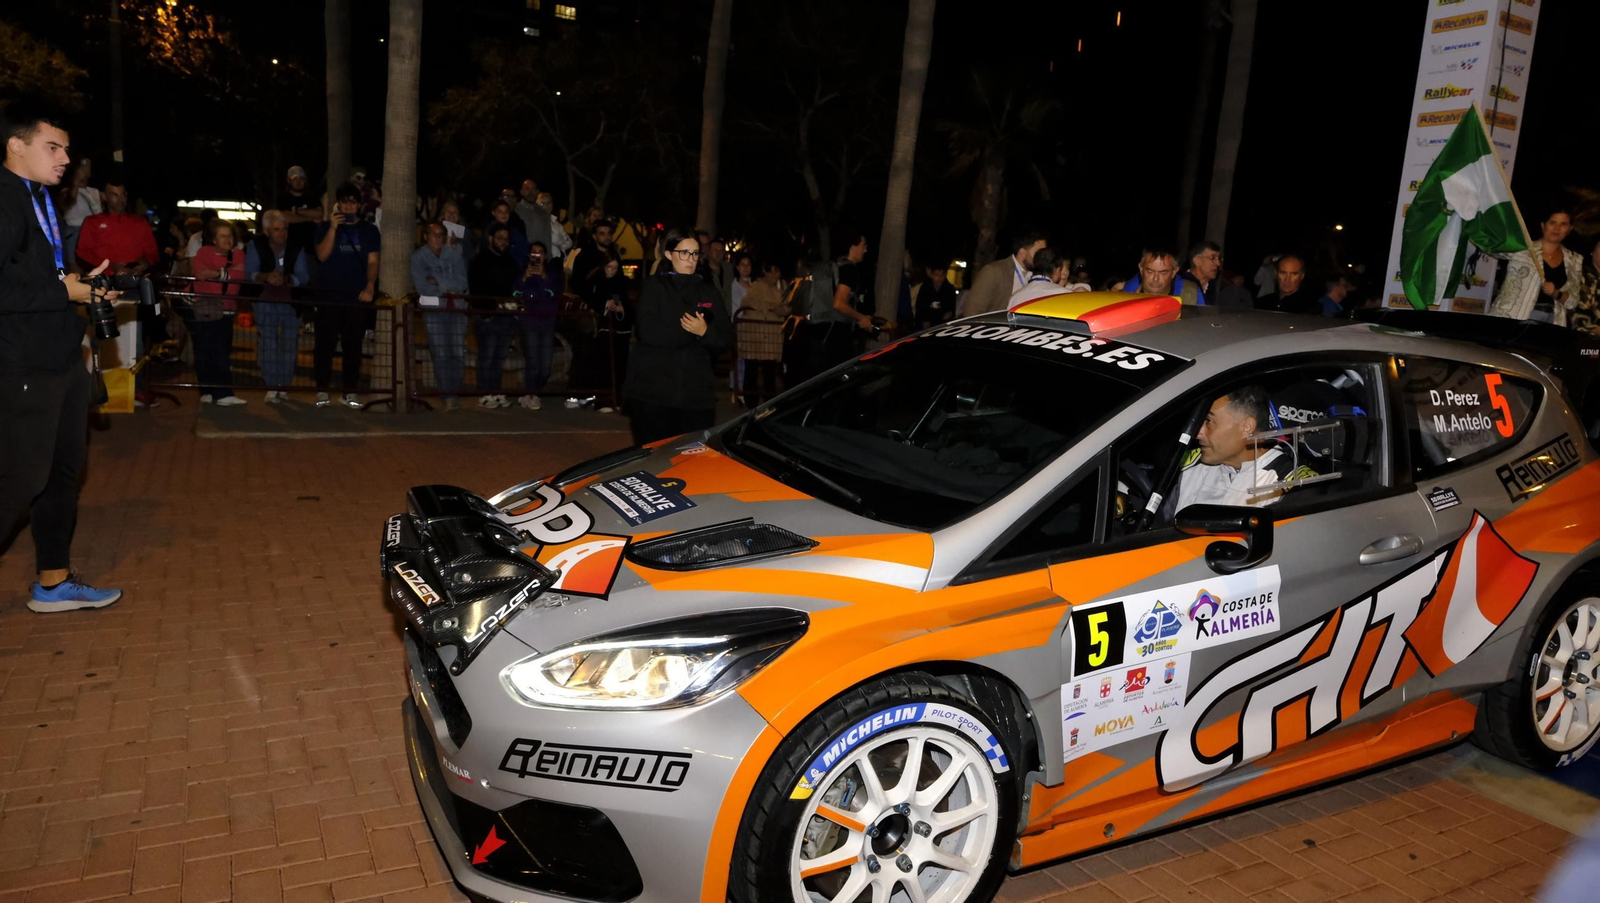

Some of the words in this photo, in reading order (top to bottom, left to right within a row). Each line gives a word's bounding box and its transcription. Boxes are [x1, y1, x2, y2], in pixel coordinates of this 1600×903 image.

[1443, 15, 1477, 28] Recalvi
[1444, 41, 1481, 51] MICHELIN
[1425, 86, 1474, 99] Rallycar
[1430, 389, 1445, 406] D.
[1445, 390, 1481, 406] Perez
[1484, 373, 1514, 438] 5
[1433, 412, 1492, 434] M.Antelo
[1223, 597, 1258, 614] COSTA
[1259, 592, 1273, 605] DE
[1211, 605, 1275, 637] ALMERÍA
[1087, 611, 1110, 667] 5
[1142, 643, 1154, 657] 30
[822, 705, 918, 768] MICHELIN
[931, 708, 958, 724] PILOT
[958, 715, 983, 735] SPORT
